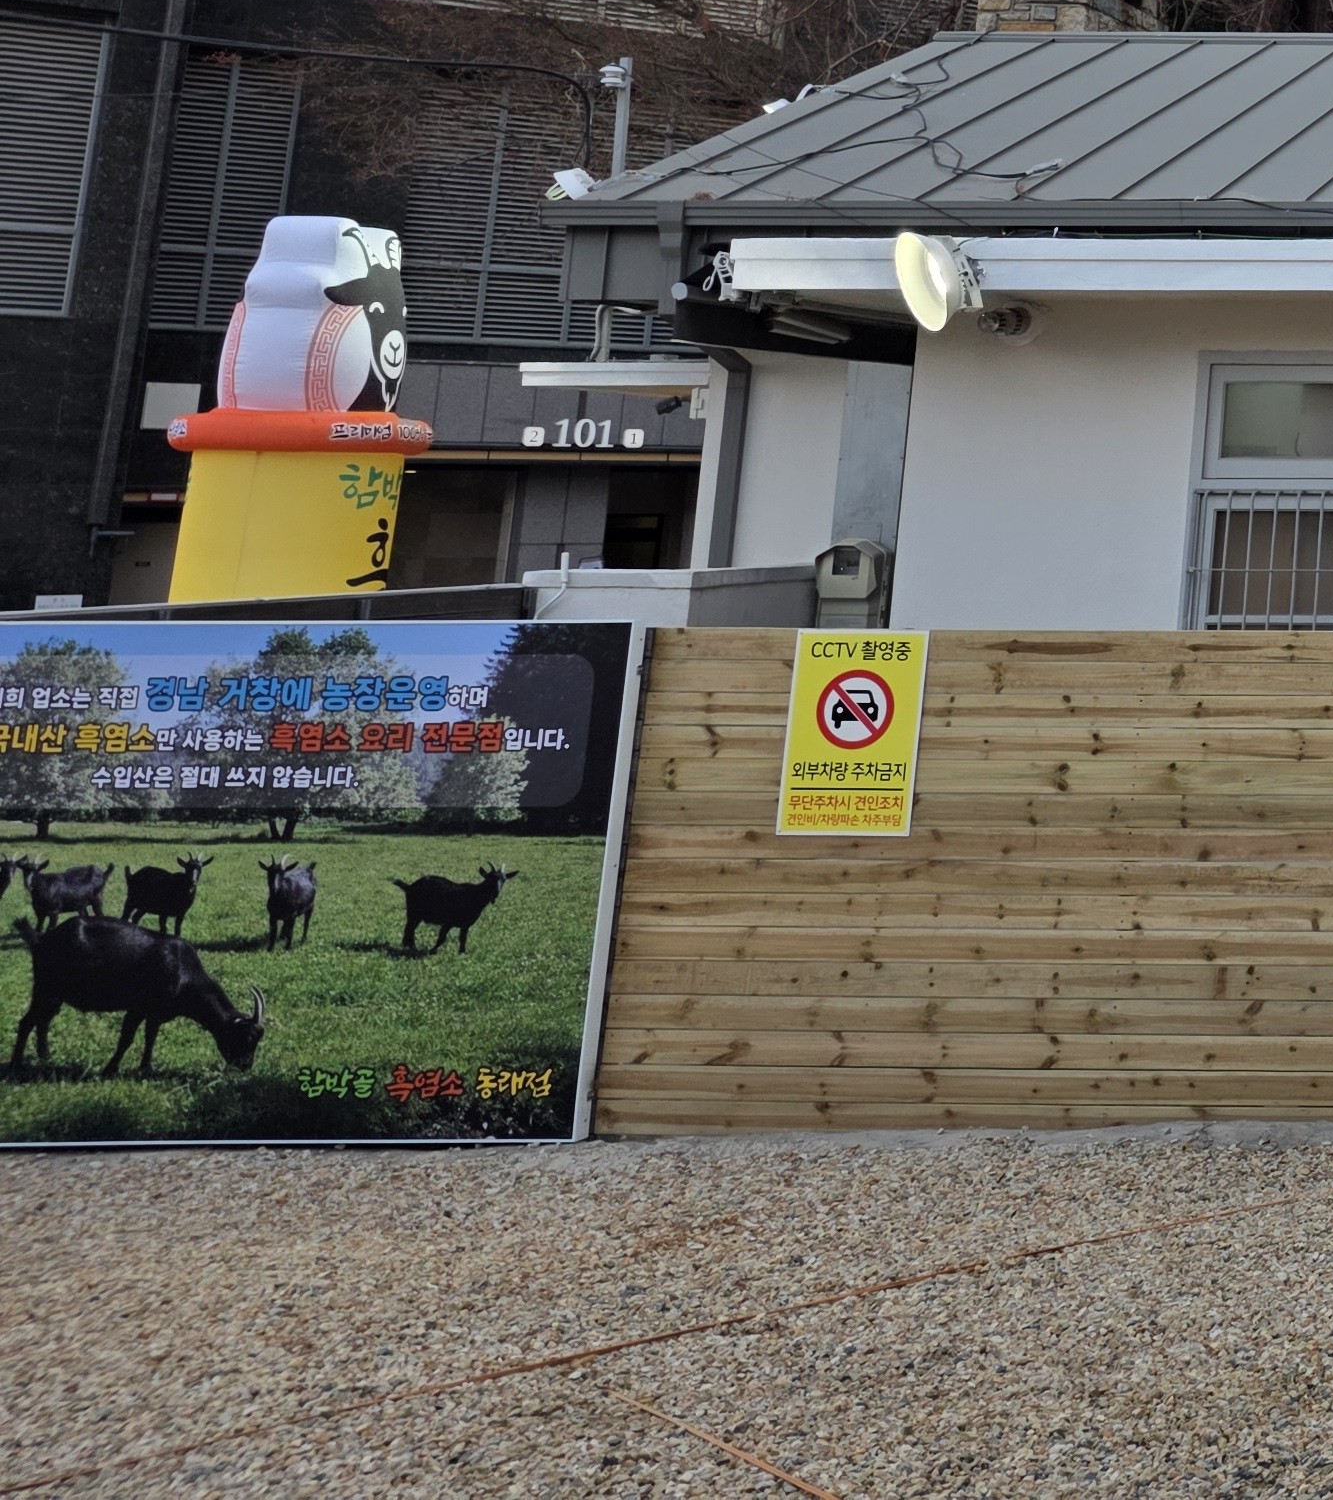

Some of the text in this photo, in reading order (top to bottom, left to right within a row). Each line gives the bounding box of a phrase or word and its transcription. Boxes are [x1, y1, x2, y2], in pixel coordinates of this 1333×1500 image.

[331, 424, 392, 440] 프리미엄
[529, 418, 637, 448] 2 101 1
[811, 641, 912, 661] CCTV 촬영중
[0, 675, 489, 712] 희 업소는 직접 경남 거창에 농장운영하며
[74, 722, 177, 753] 흑염소만
[182, 728, 264, 752] 사용하는
[269, 722, 350, 754] 흑염소
[357, 722, 414, 753] 요리
[420, 721, 570, 753] 전문점입니다.
[91, 765, 359, 789] 수입산은 절대 쓰지 않습니다.
[791, 761, 907, 782] 외부차량 주차금지
[788, 795, 904, 811] 무단주차시 견인조치
[787, 813, 902, 827] 견인비/차량파손 차주부담
[298, 1064, 552, 1102] 함박골 흑염소 동래점
